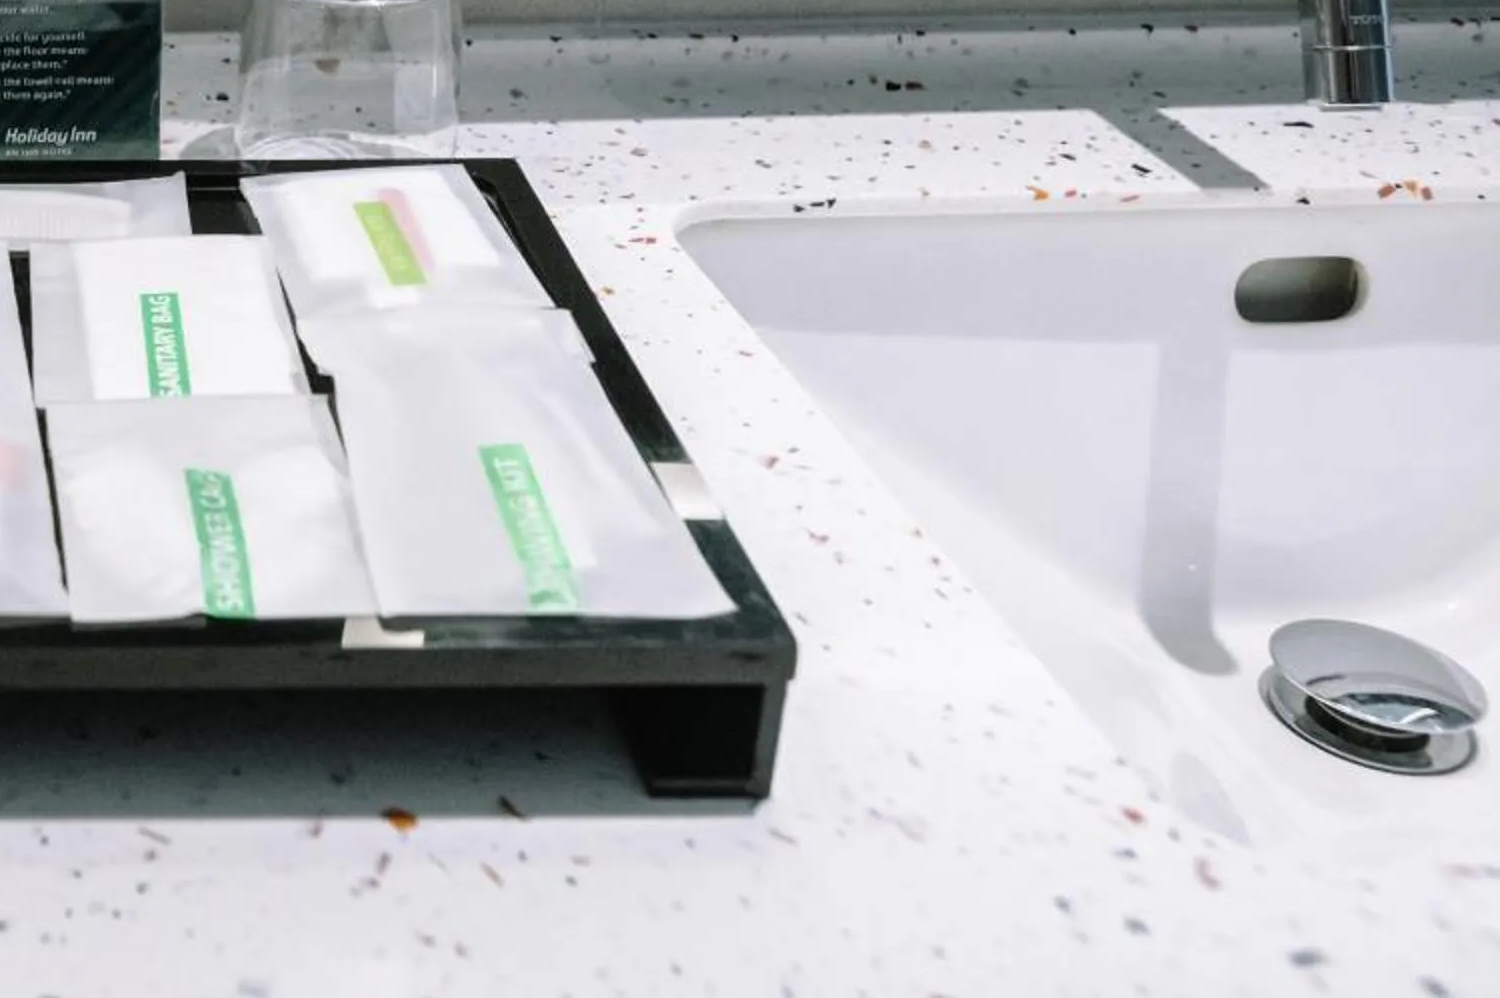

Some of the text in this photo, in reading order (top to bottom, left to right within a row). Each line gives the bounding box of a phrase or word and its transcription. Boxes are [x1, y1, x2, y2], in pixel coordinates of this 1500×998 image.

[3, 47, 21, 56] the
[3, 77, 21, 87] the
[5, 127, 69, 147] Holiday
[69, 125, 97, 143] Inn
[147, 294, 173, 324] BAG
[204, 510, 246, 613] SHOWER
